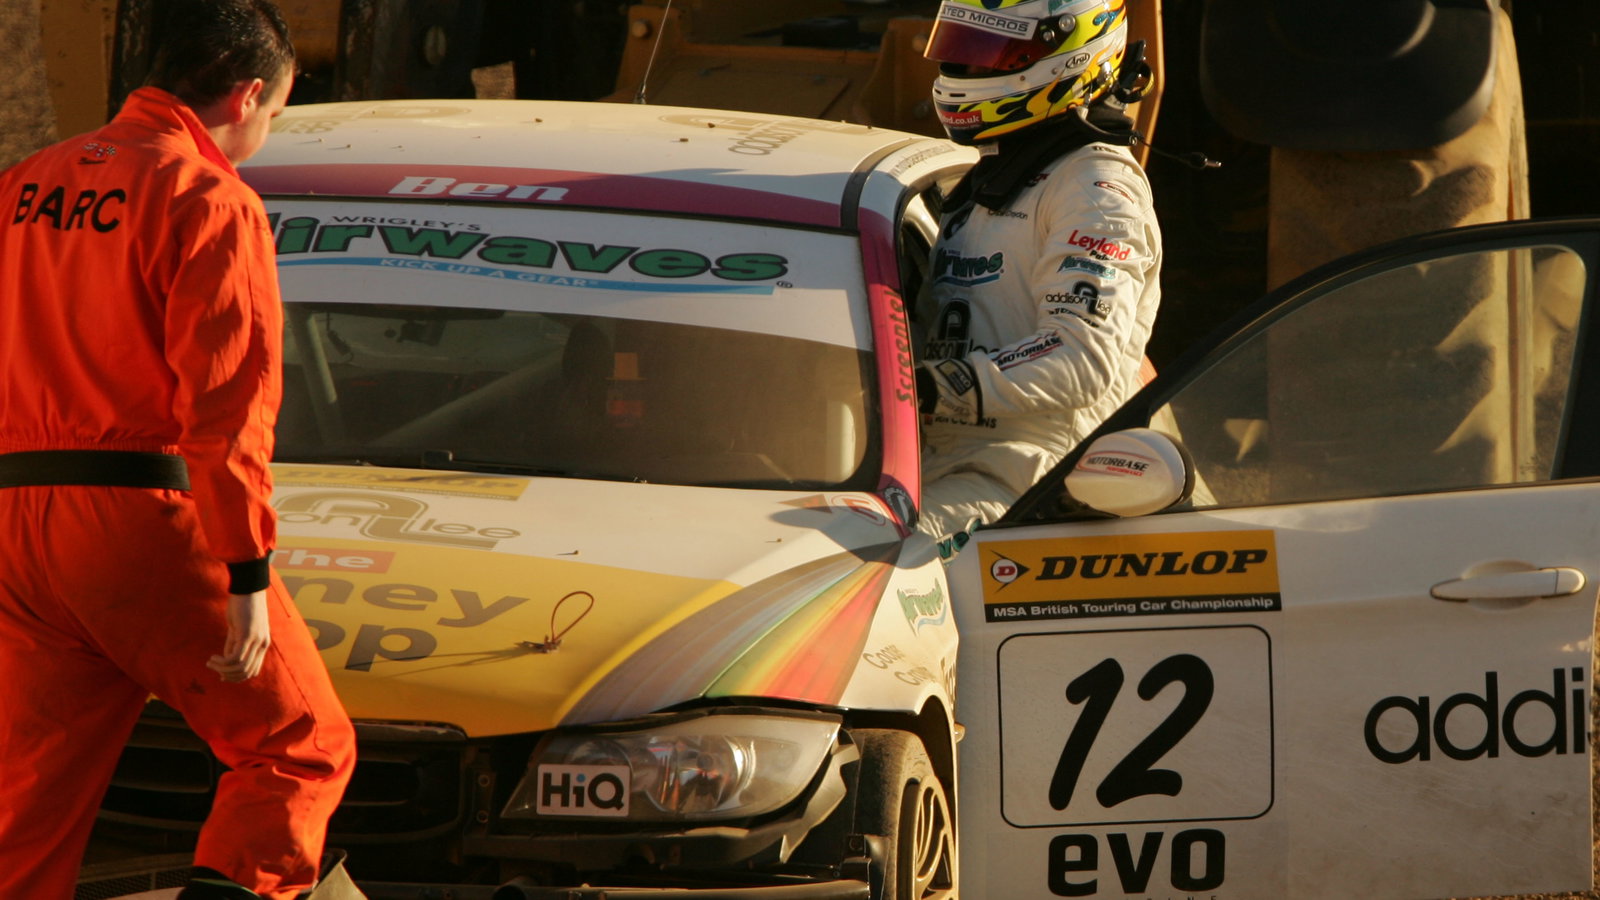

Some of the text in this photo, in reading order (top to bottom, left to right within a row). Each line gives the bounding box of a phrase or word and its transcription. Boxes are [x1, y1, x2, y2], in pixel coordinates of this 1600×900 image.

[969, 13, 1029, 32] MICROS
[387, 176, 570, 201] Ben
[12, 183, 127, 233] BARC
[332, 216, 481, 231] WRIGLEY'S
[266, 213, 788, 281] irwaves
[1067, 229, 1131, 261] Leyland
[380, 257, 437, 271] KICK
[447, 263, 481, 276] UP
[486, 269, 505, 279] A
[1045, 292, 1089, 305] addison
[1086, 456, 1150, 471] MOTORBASE
[419, 518, 522, 539] lee
[1035, 548, 1268, 581] DUNLOP
[281, 576, 530, 628] ney
[994, 596, 1274, 618] MSA British Touring Car Championship
[302, 618, 437, 672] op
[1364, 667, 1592, 764] addi
[1048, 653, 1214, 811] 12
[541, 772, 625, 810] HiQ
[1048, 828, 1226, 897] evo
